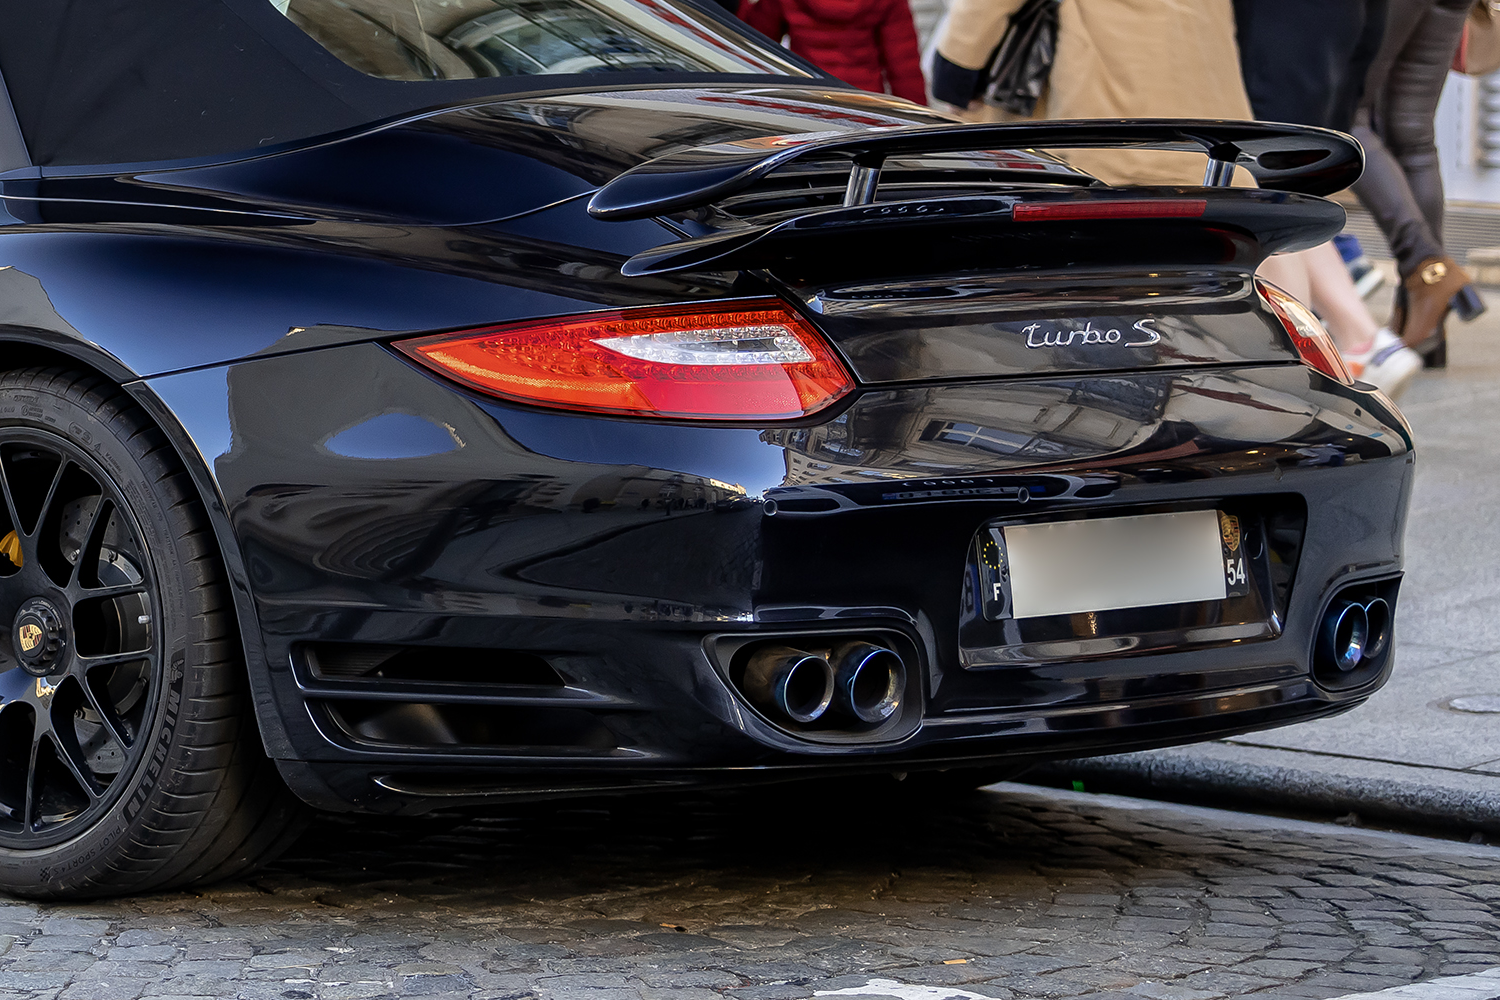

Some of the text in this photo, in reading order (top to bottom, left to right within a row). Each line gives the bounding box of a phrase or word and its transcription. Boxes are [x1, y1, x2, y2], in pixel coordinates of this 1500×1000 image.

[1021, 318, 1162, 349] turbo S
[1226, 558, 1245, 586] 54
[993, 582, 1001, 601] F
[127, 691, 181, 818] MICHELIN
[97, 826, 122, 853] PILOT
[65, 849, 96, 873] SPORT
